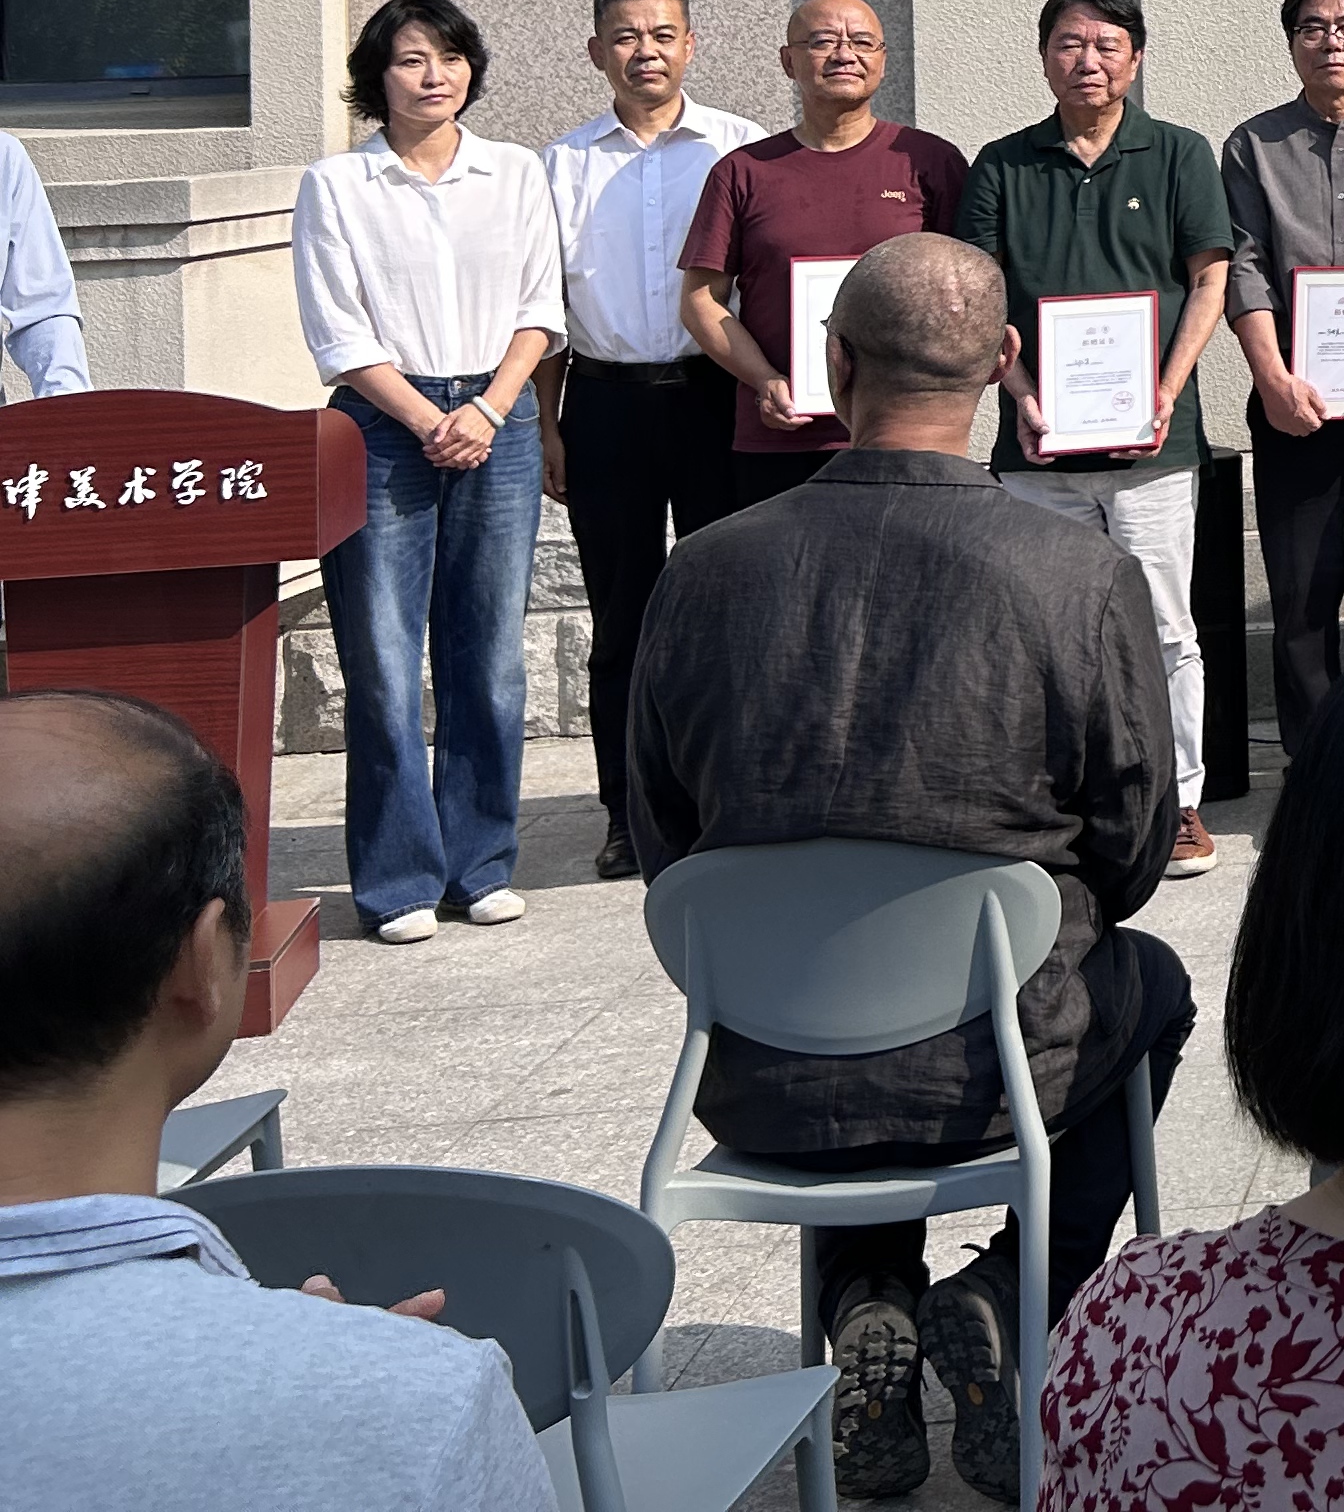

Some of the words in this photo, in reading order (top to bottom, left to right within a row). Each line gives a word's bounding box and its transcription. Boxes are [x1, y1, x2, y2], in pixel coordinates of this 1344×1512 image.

[881, 189, 905, 200] Jeep
[2, 459, 268, 520] 津美术学院
